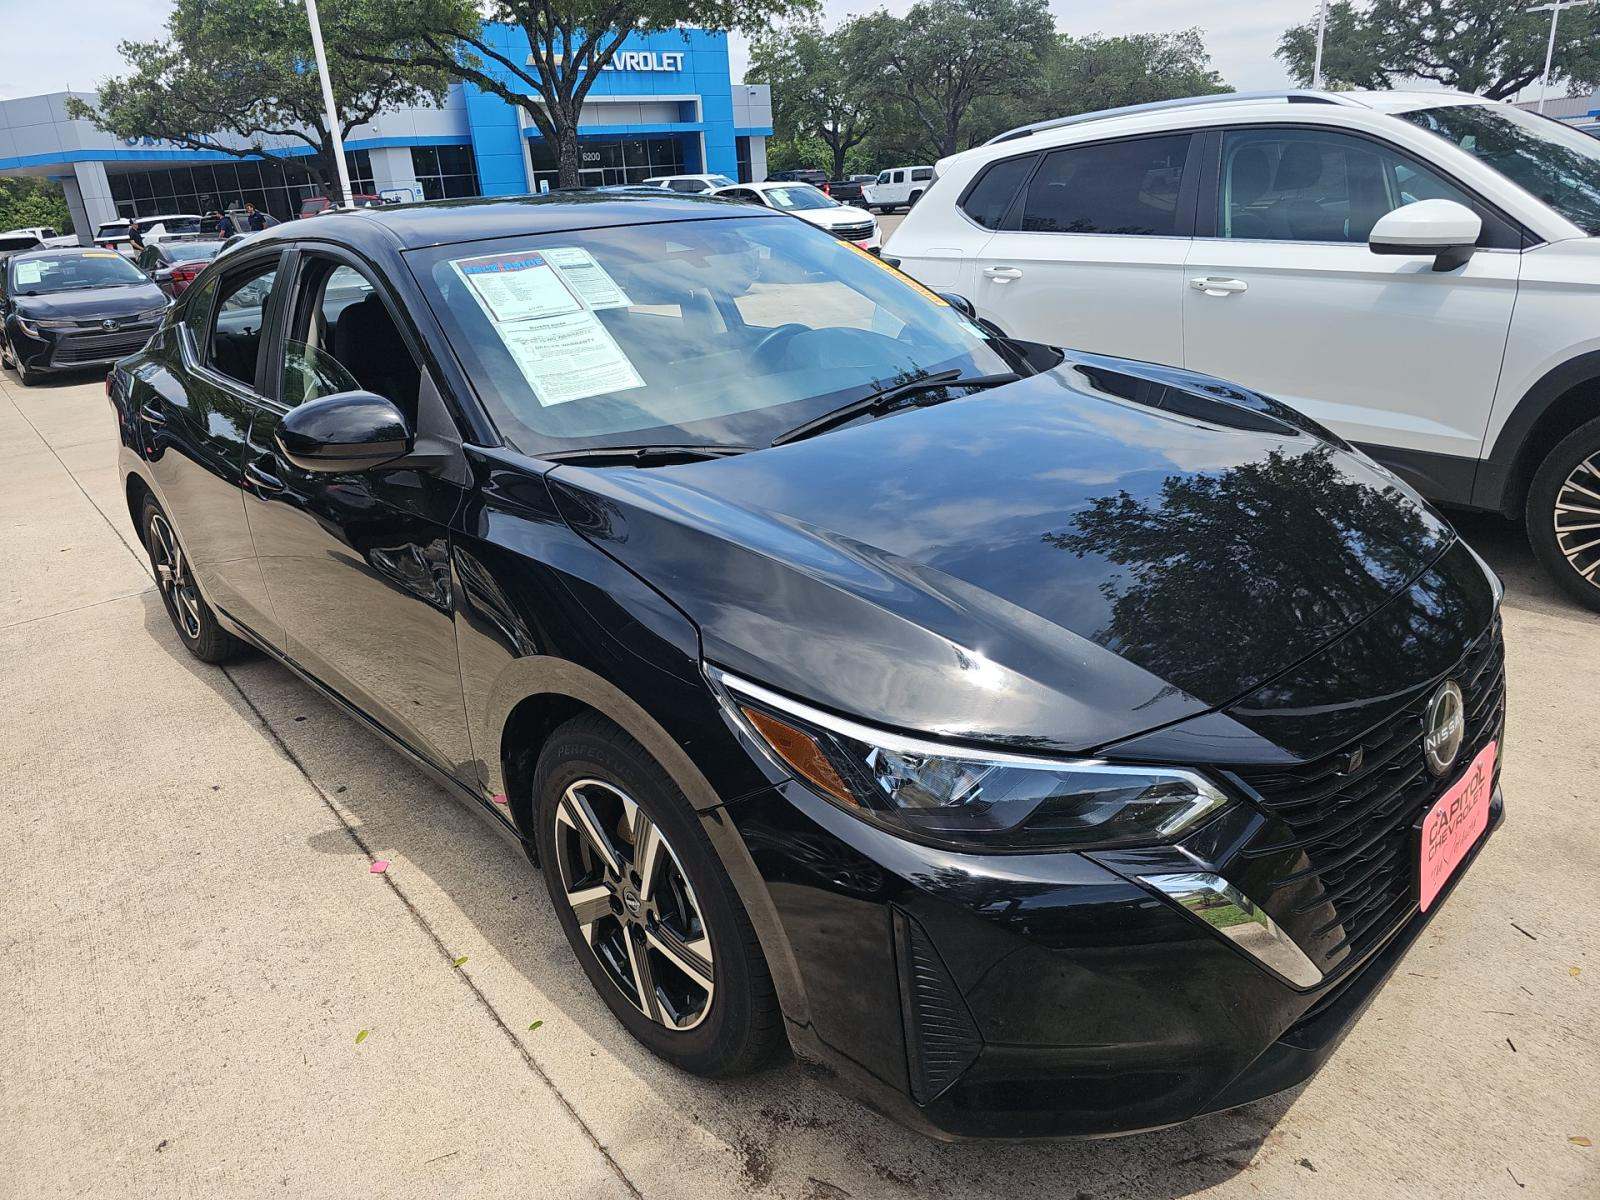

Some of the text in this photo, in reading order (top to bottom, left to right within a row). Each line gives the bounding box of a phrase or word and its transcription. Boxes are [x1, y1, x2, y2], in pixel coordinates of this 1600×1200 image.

[571, 51, 684, 71] VROLET
[583, 152, 600, 161] 6200
[1429, 766, 1486, 845] CAPITOL
[1429, 785, 1485, 862] CHEVROLET
